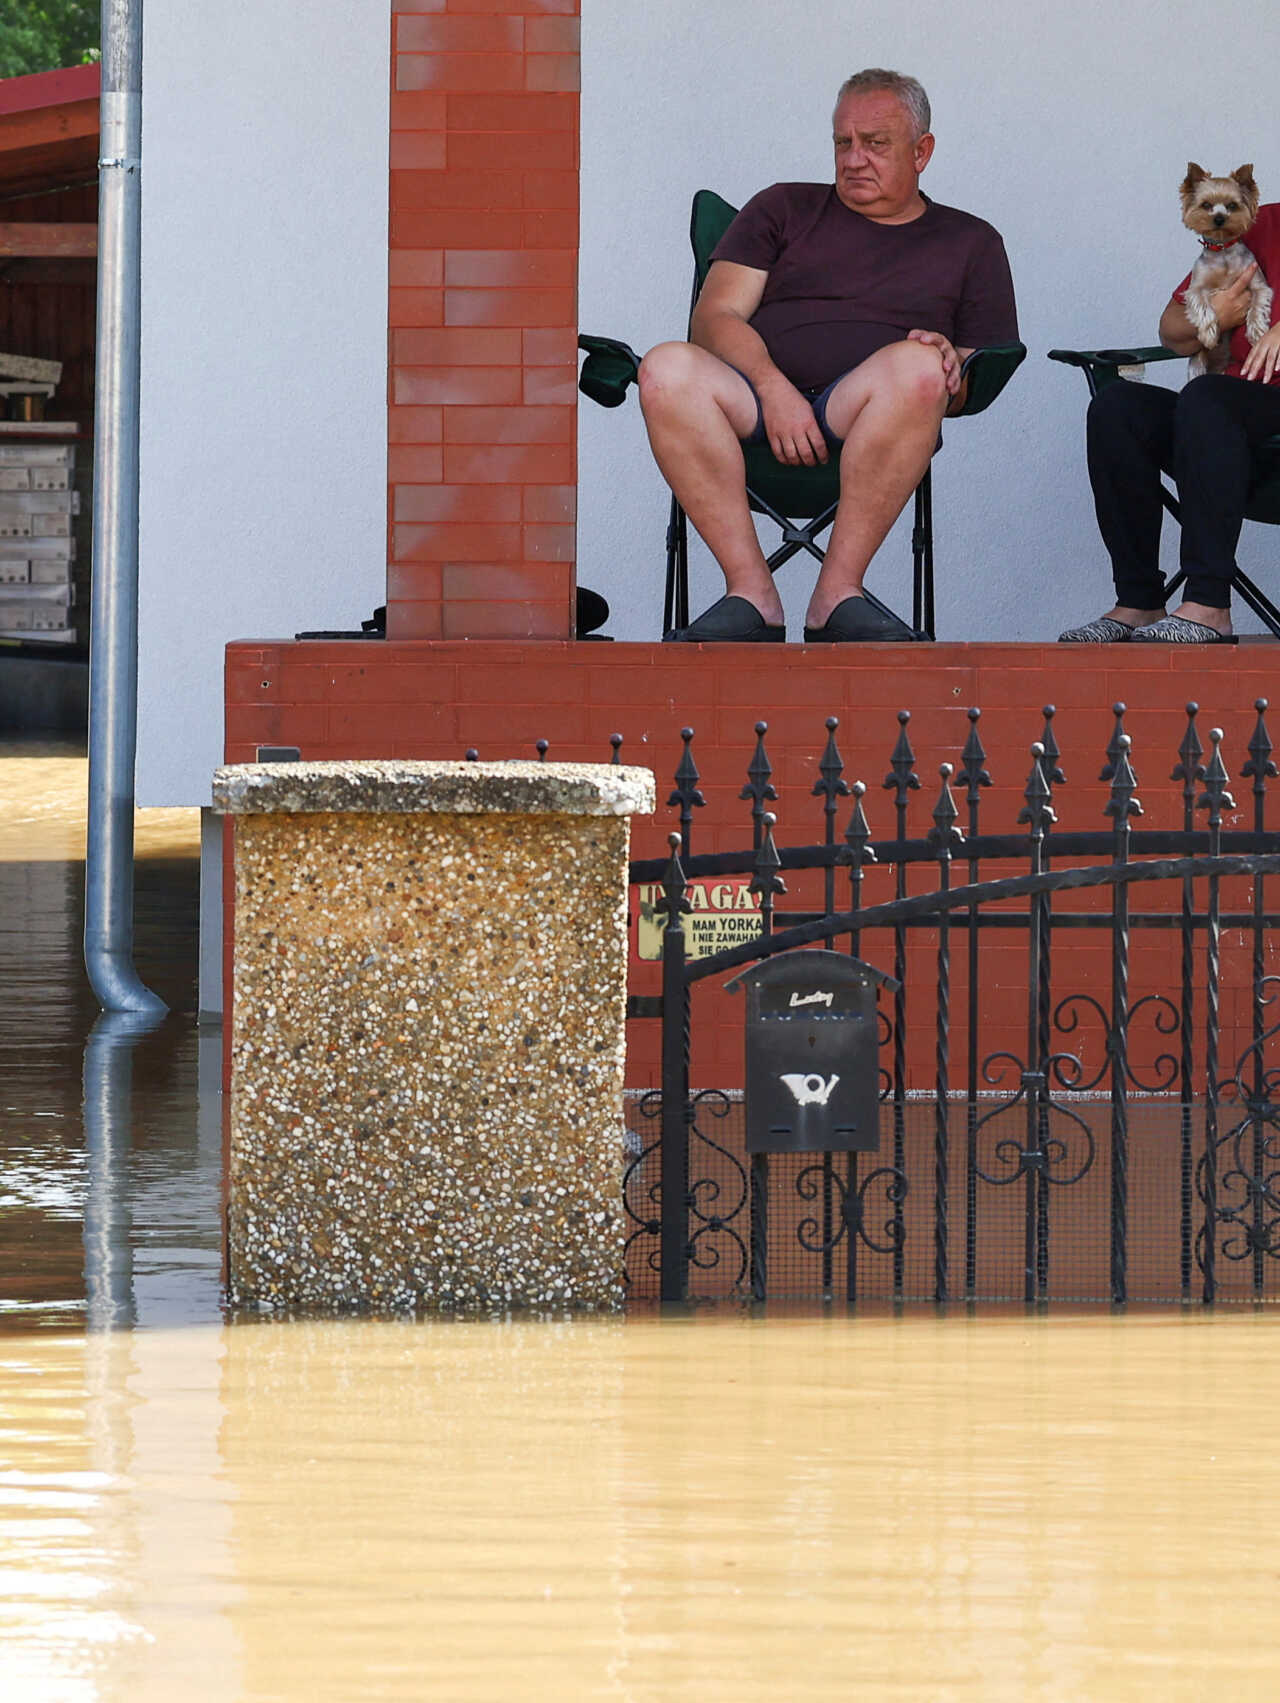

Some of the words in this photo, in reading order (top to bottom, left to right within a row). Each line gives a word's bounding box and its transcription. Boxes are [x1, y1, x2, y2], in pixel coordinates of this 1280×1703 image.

[639, 884, 763, 910] UAGA
[692, 920, 716, 931] MAM
[693, 933, 696, 942] I
[699, 933, 714, 942] NIE
